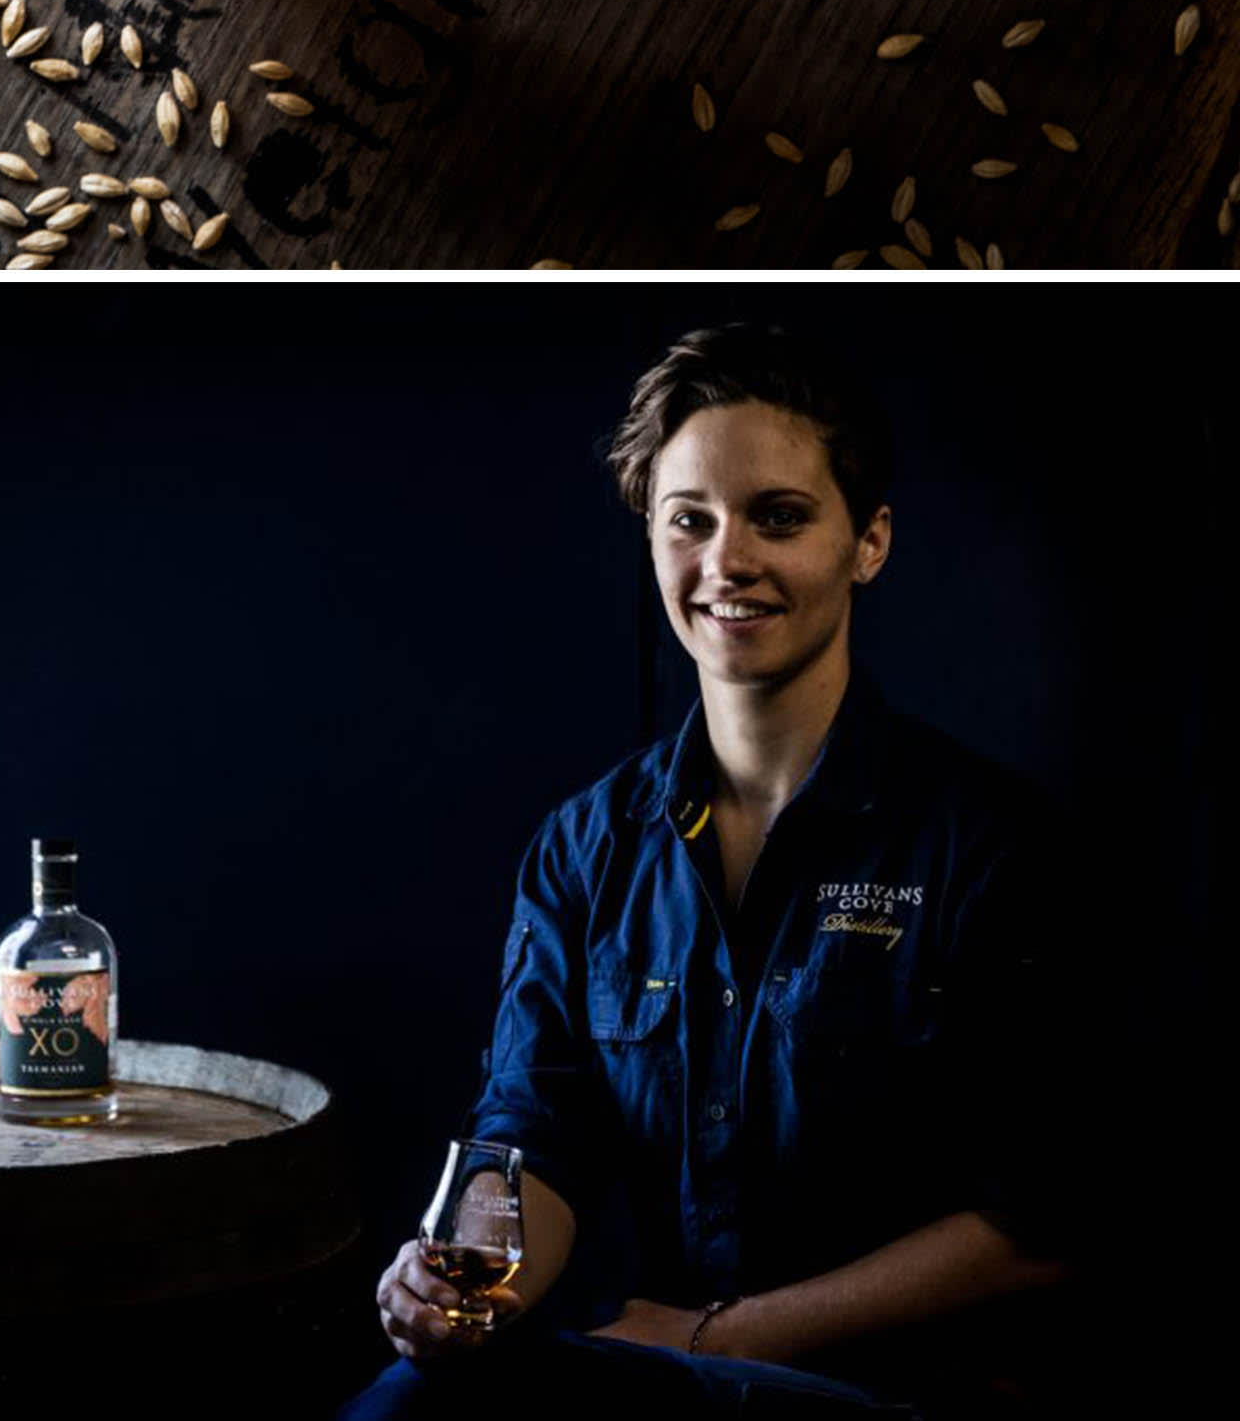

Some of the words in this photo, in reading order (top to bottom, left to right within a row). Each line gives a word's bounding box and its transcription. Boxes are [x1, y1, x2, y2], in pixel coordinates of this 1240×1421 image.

[817, 883, 923, 905] SULLIVANS
[838, 896, 893, 914] COVE
[819, 913, 903, 951] Distillery
[29, 1026, 79, 1056] XO
